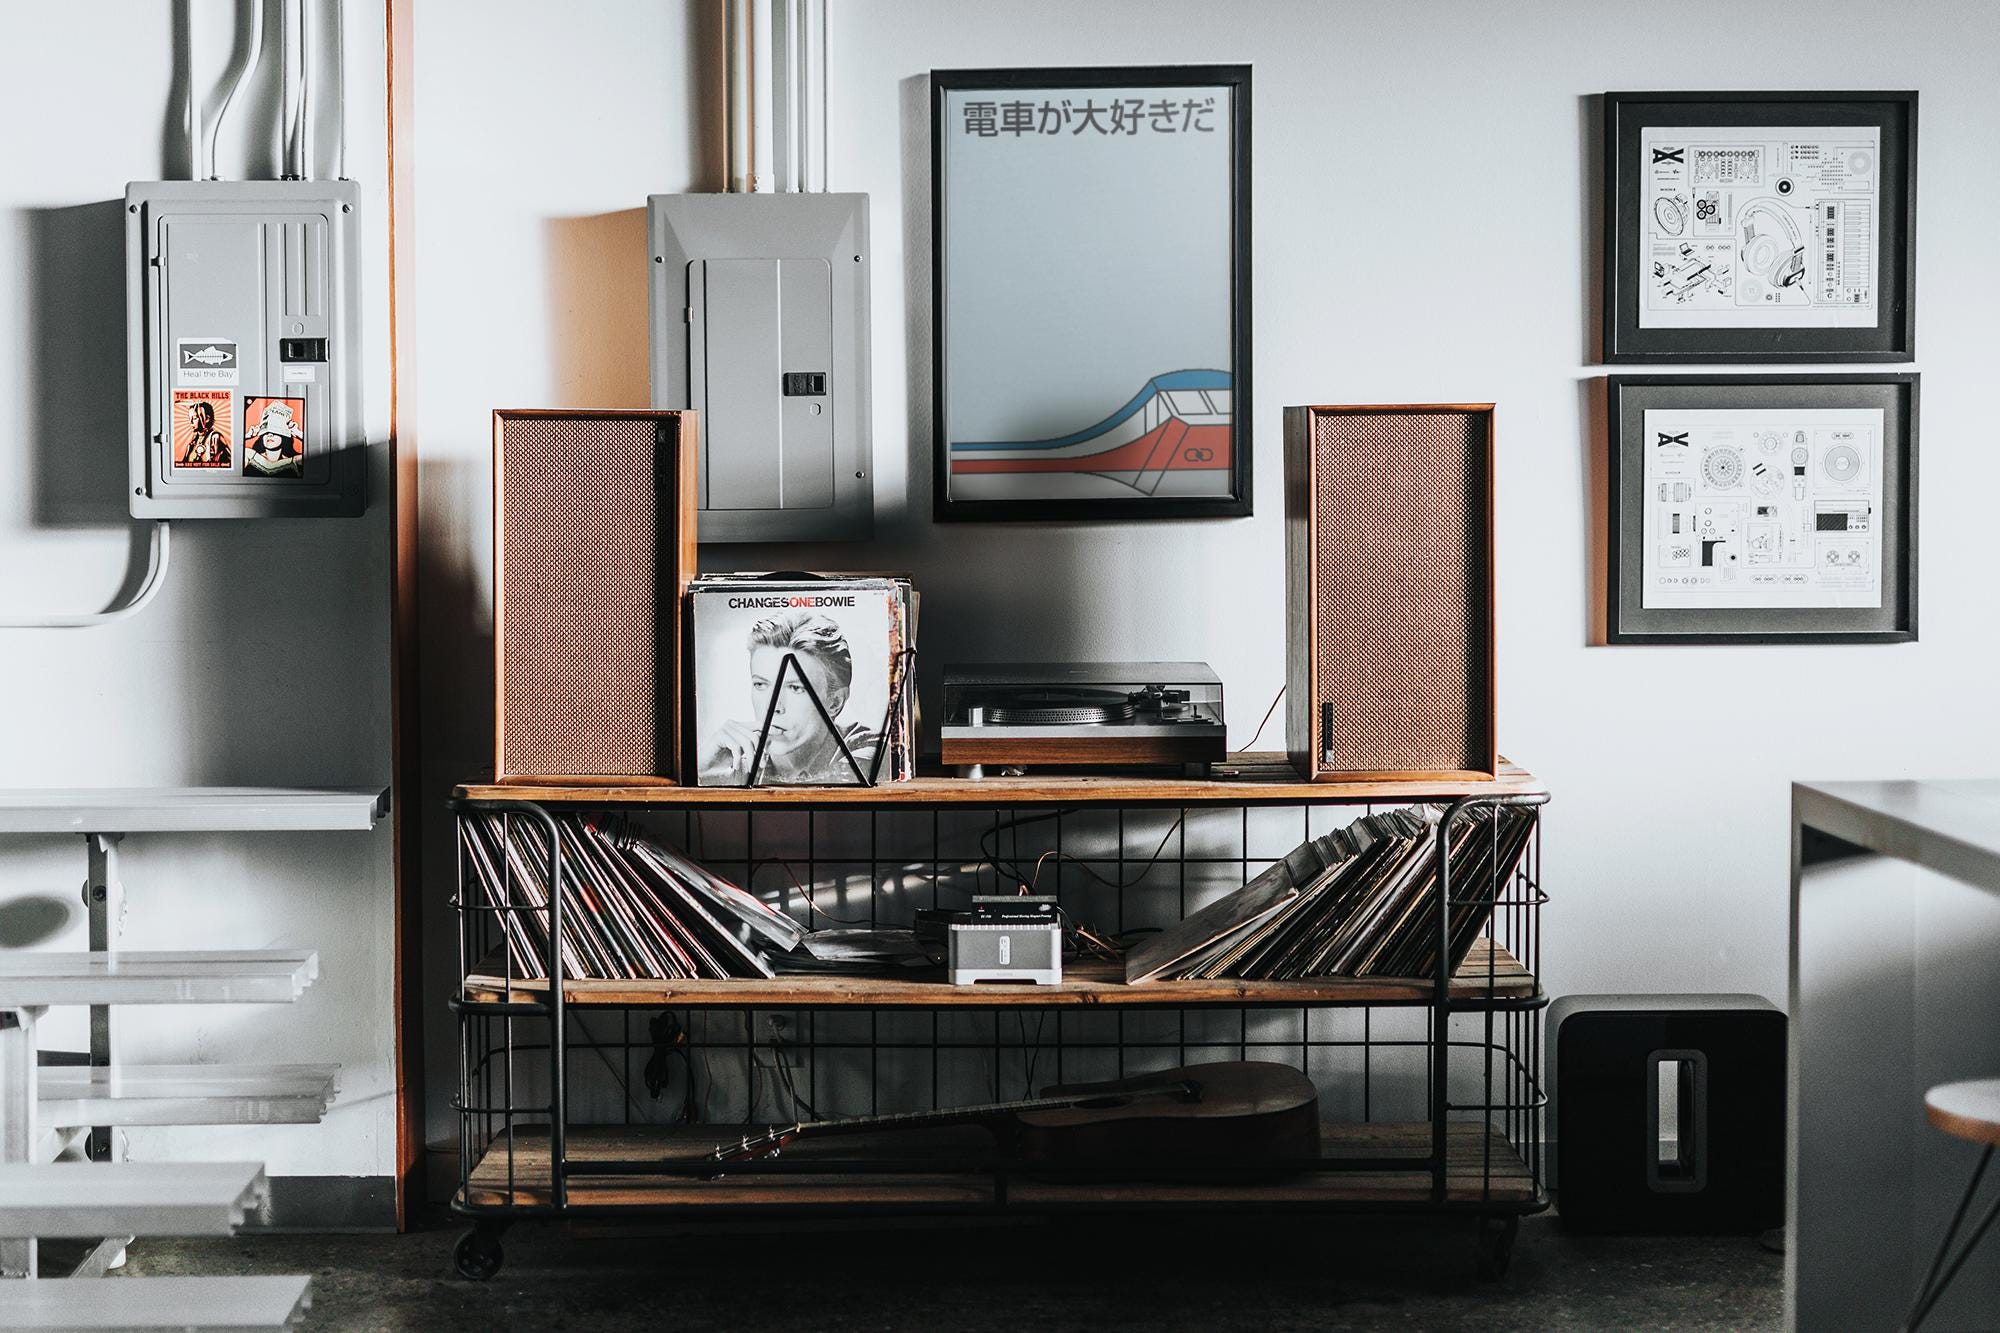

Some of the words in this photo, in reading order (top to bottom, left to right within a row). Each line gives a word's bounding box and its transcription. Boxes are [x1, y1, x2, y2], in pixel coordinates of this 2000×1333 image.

[963, 97, 1216, 138] 電車が大好きだ
[183, 370, 202, 378] Heal
[203, 370, 216, 378] the
[218, 370, 234, 380] Bay
[728, 596, 855, 609] CHANGESONEBOWIE
